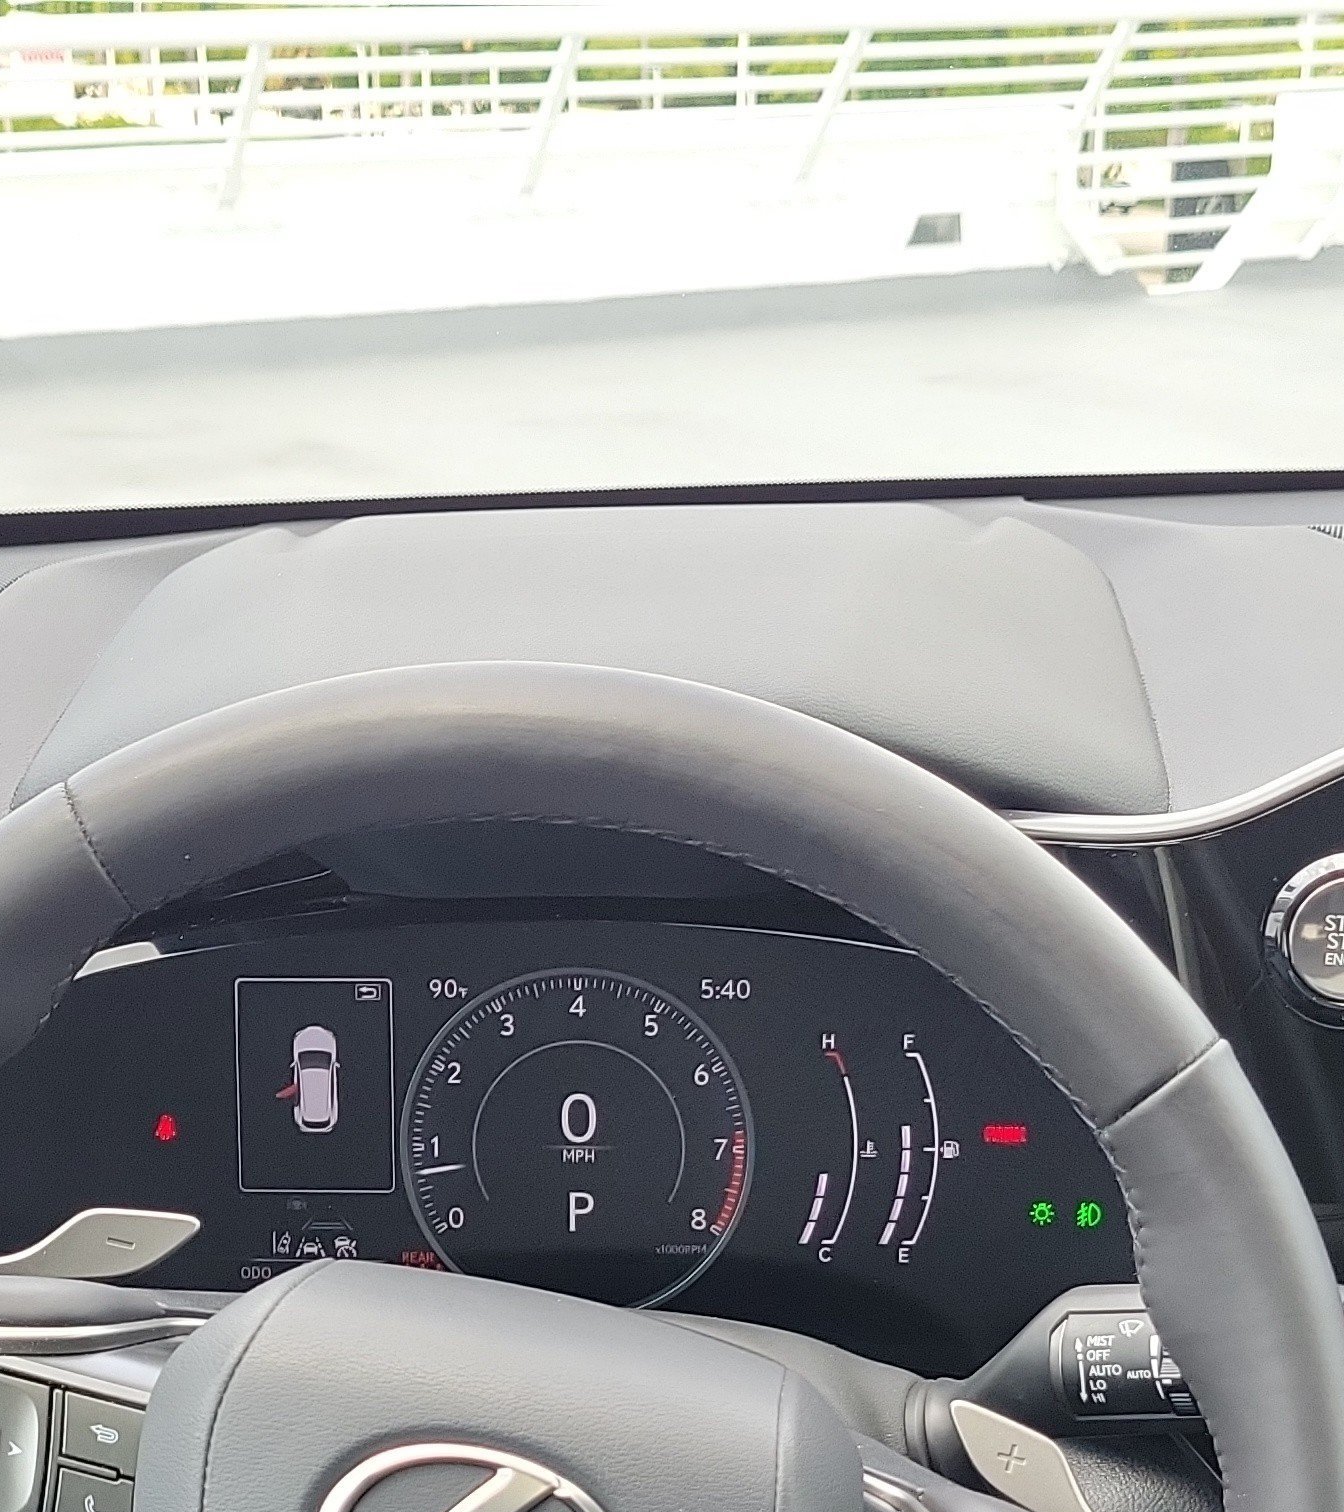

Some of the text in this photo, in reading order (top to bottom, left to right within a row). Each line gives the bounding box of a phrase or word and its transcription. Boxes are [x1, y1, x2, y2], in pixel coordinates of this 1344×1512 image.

[701, 979, 750, 999] 5:40
[569, 995, 586, 1017] 4
[500, 1014, 515, 1036] 3
[644, 1014, 658, 1036] 5
[822, 1034, 835, 1049] H
[904, 1034, 915, 1049] F
[447, 1062, 462, 1084] 2
[694, 1064, 709, 1085] 6
[561, 1093, 597, 1143] 0
[430, 1136, 439, 1157] 1
[713, 1139, 728, 1160] 7
[562, 1150, 595, 1164] MPH
[448, 1207, 464, 1228] 0
[569, 1192, 594, 1231] P
[691, 1208, 706, 1230] 8
[818, 1248, 832, 1263] C
[898, 1248, 909, 1263] E
[240, 1266, 272, 1279] ODO
[1086, 1335, 1115, 1347] MIST
[1086, 1349, 1110, 1361] OFF
[1089, 1364, 1122, 1376] AUTO
[1127, 1369, 1151, 1380] AUTO
[1090, 1379, 1107, 1390] LO
[1092, 1391, 1106, 1404] HI
